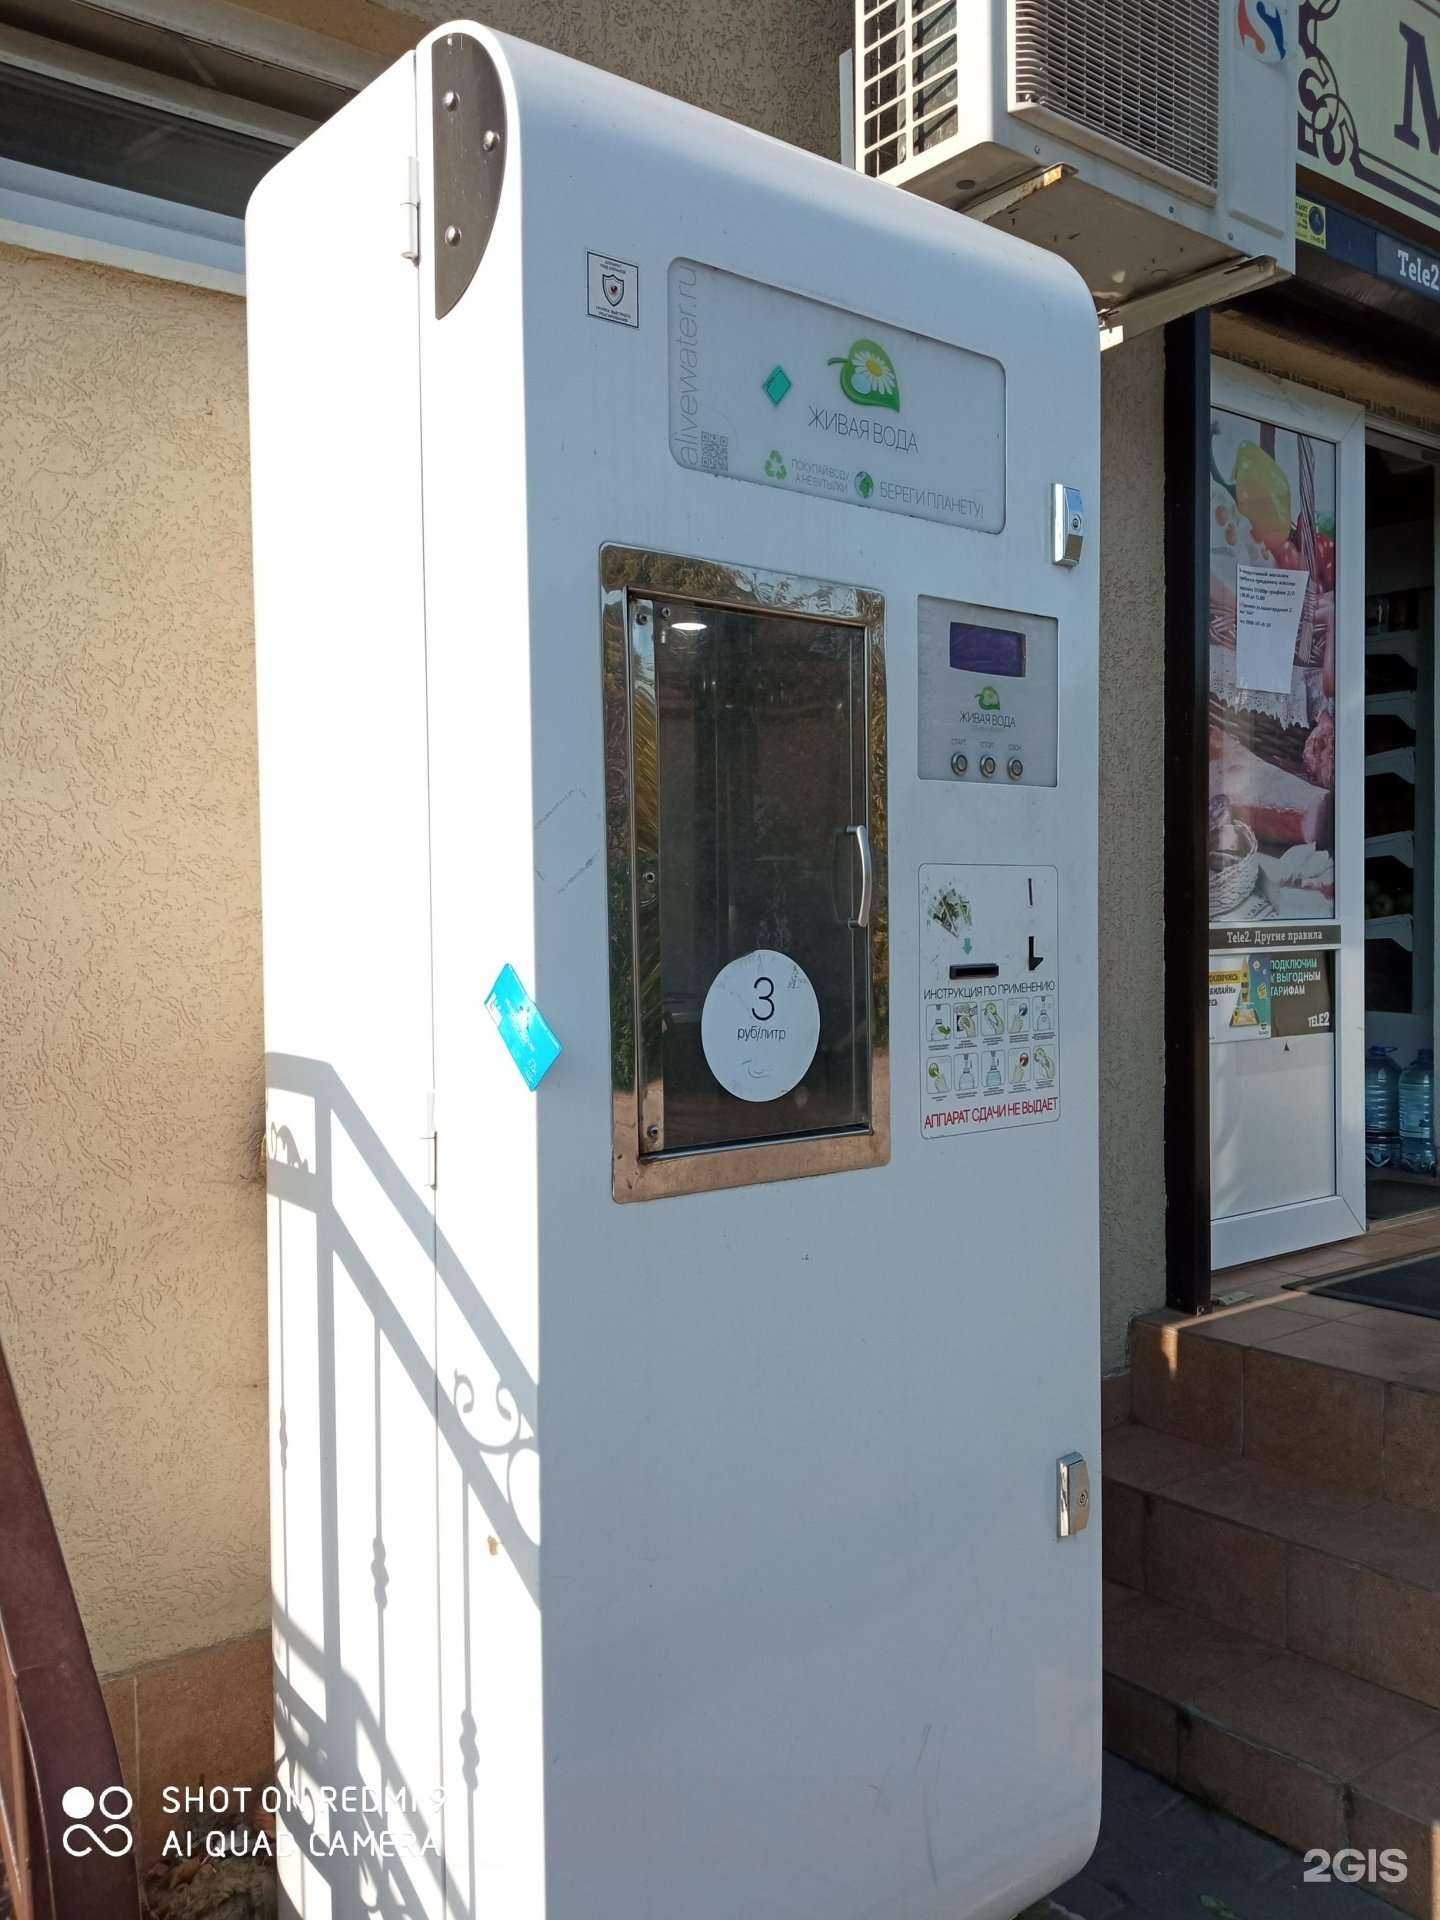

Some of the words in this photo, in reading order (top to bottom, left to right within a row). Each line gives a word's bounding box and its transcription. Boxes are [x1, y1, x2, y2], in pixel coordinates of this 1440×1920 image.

[1398, 249, 1440, 291] Tele2
[672, 265, 700, 468] alivewater.ru
[807, 405, 870, 446] ЖИВАЯ
[873, 425, 919, 456] ВОДА
[880, 480, 926, 505] БЕРЕГИ
[959, 711, 991, 726] ЖИВАЯ
[992, 713, 1016, 729] ВОДА
[1254, 931, 1286, 945] Другие
[1287, 930, 1323, 943] правила
[752, 976, 775, 1021] 3
[923, 986, 983, 1001] ИНСТРУКЦИЯ
[984, 984, 997, 997] ПО
[997, 980, 1056, 995] ПРИМЕНЕНИЮ
[1308, 1011, 1330, 1028] TELE2
[737, 1025, 786, 1042] руб/литр
[924, 1109, 971, 1130] АППАРАТ
[971, 1104, 1007, 1124] СДАЧИ
[1008, 1102, 1022, 1117] НЕ
[1022, 1096, 1058, 1115] ВЫДАЕТ
